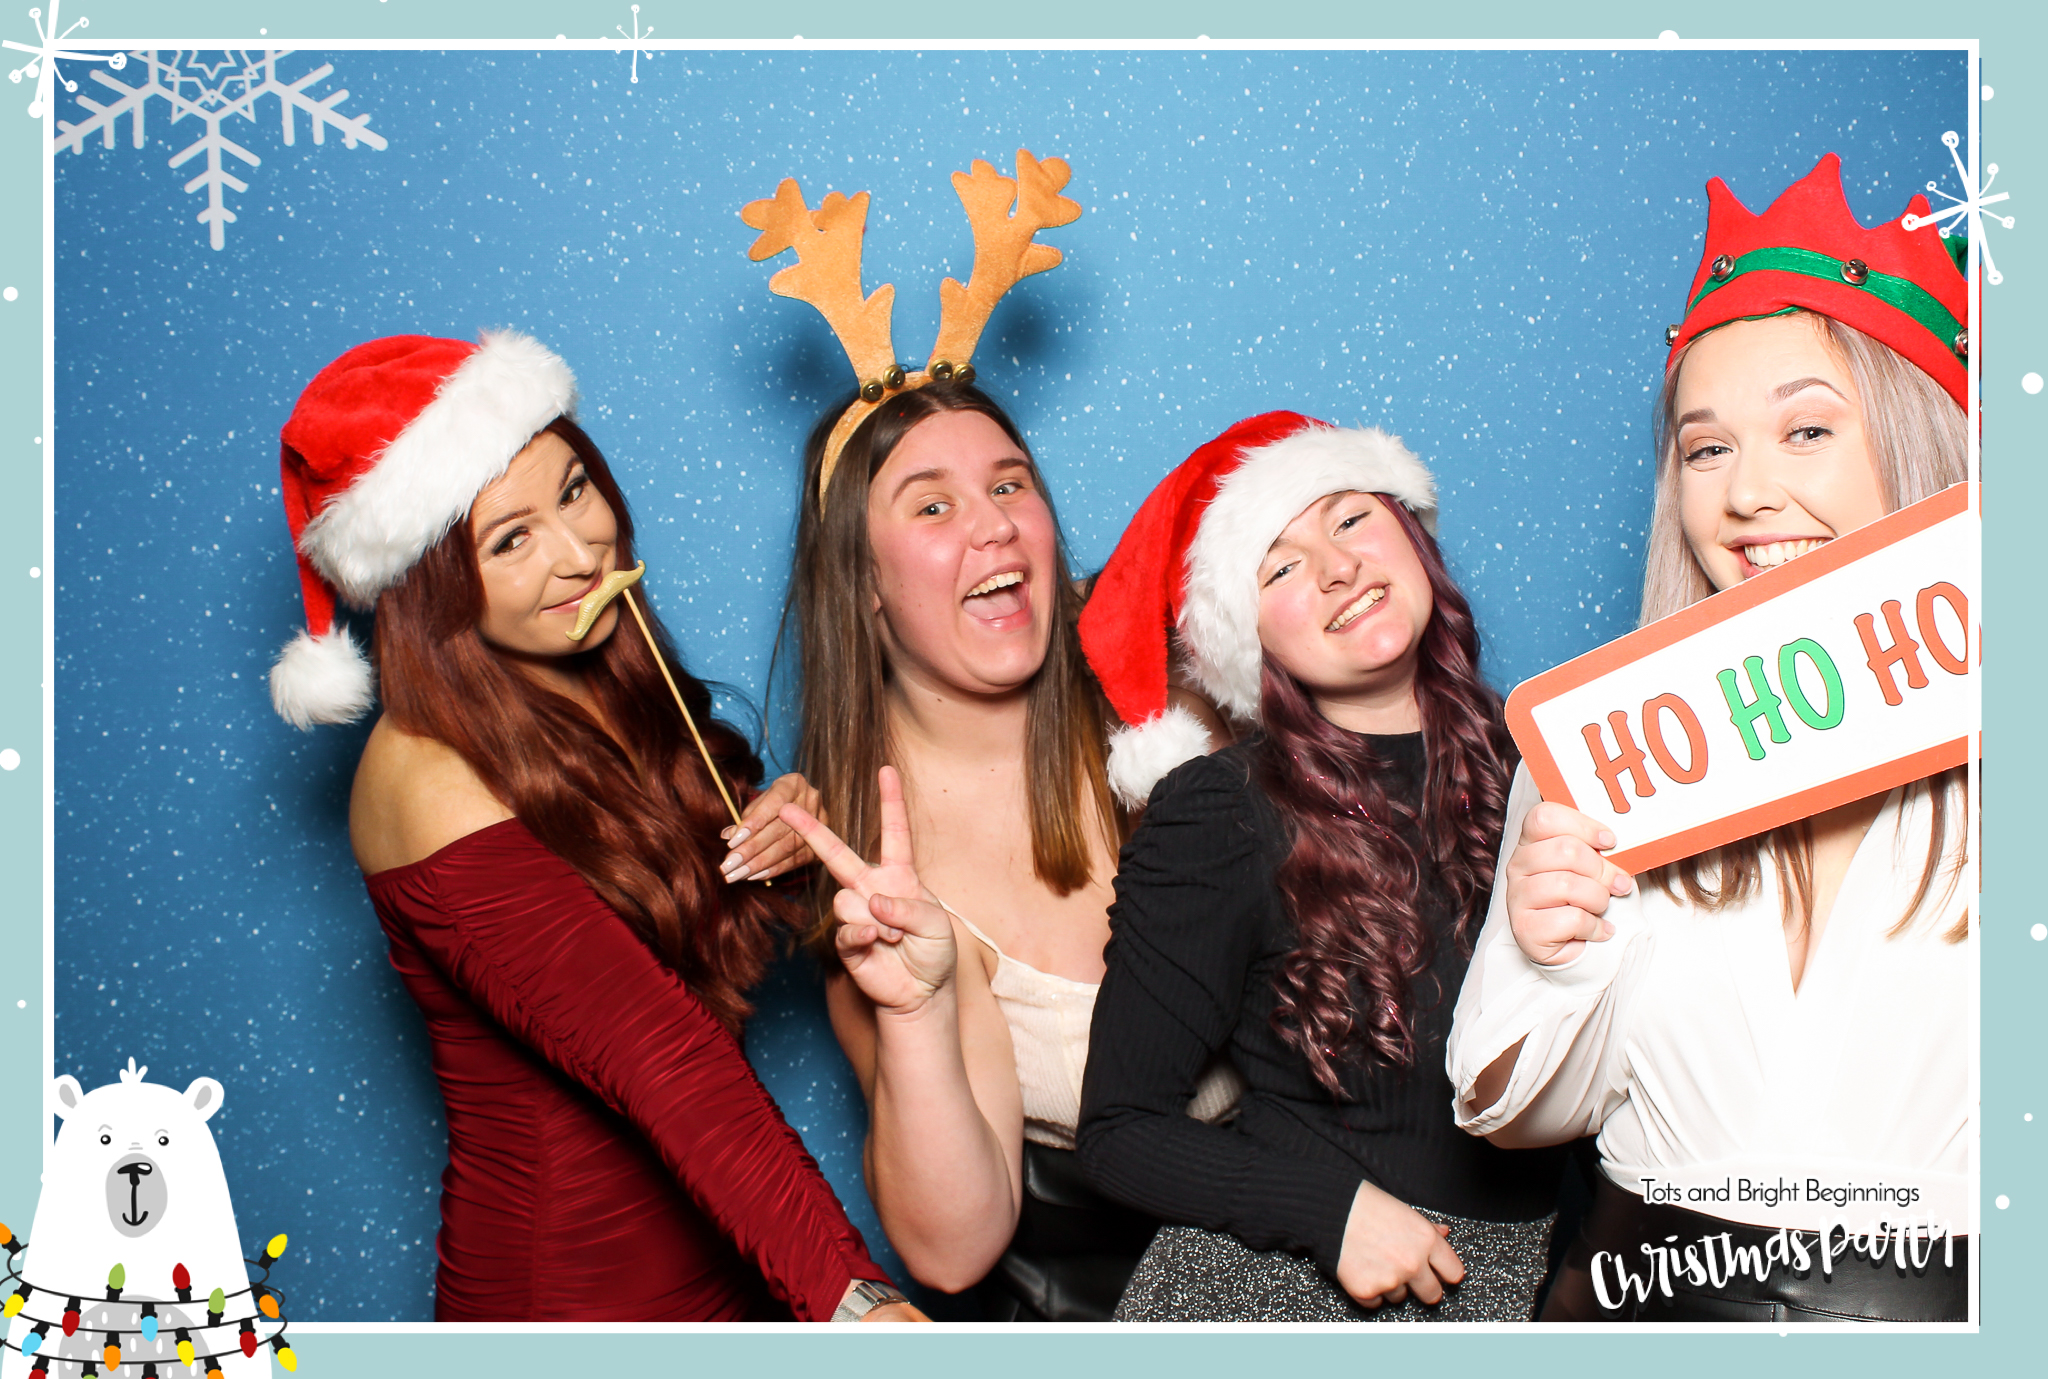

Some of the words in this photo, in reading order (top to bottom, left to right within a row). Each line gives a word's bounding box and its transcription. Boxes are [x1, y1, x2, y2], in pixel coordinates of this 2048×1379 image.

[1581, 692, 1708, 814] HO
[1716, 637, 1845, 761] HO
[1853, 581, 1982, 706] HO
